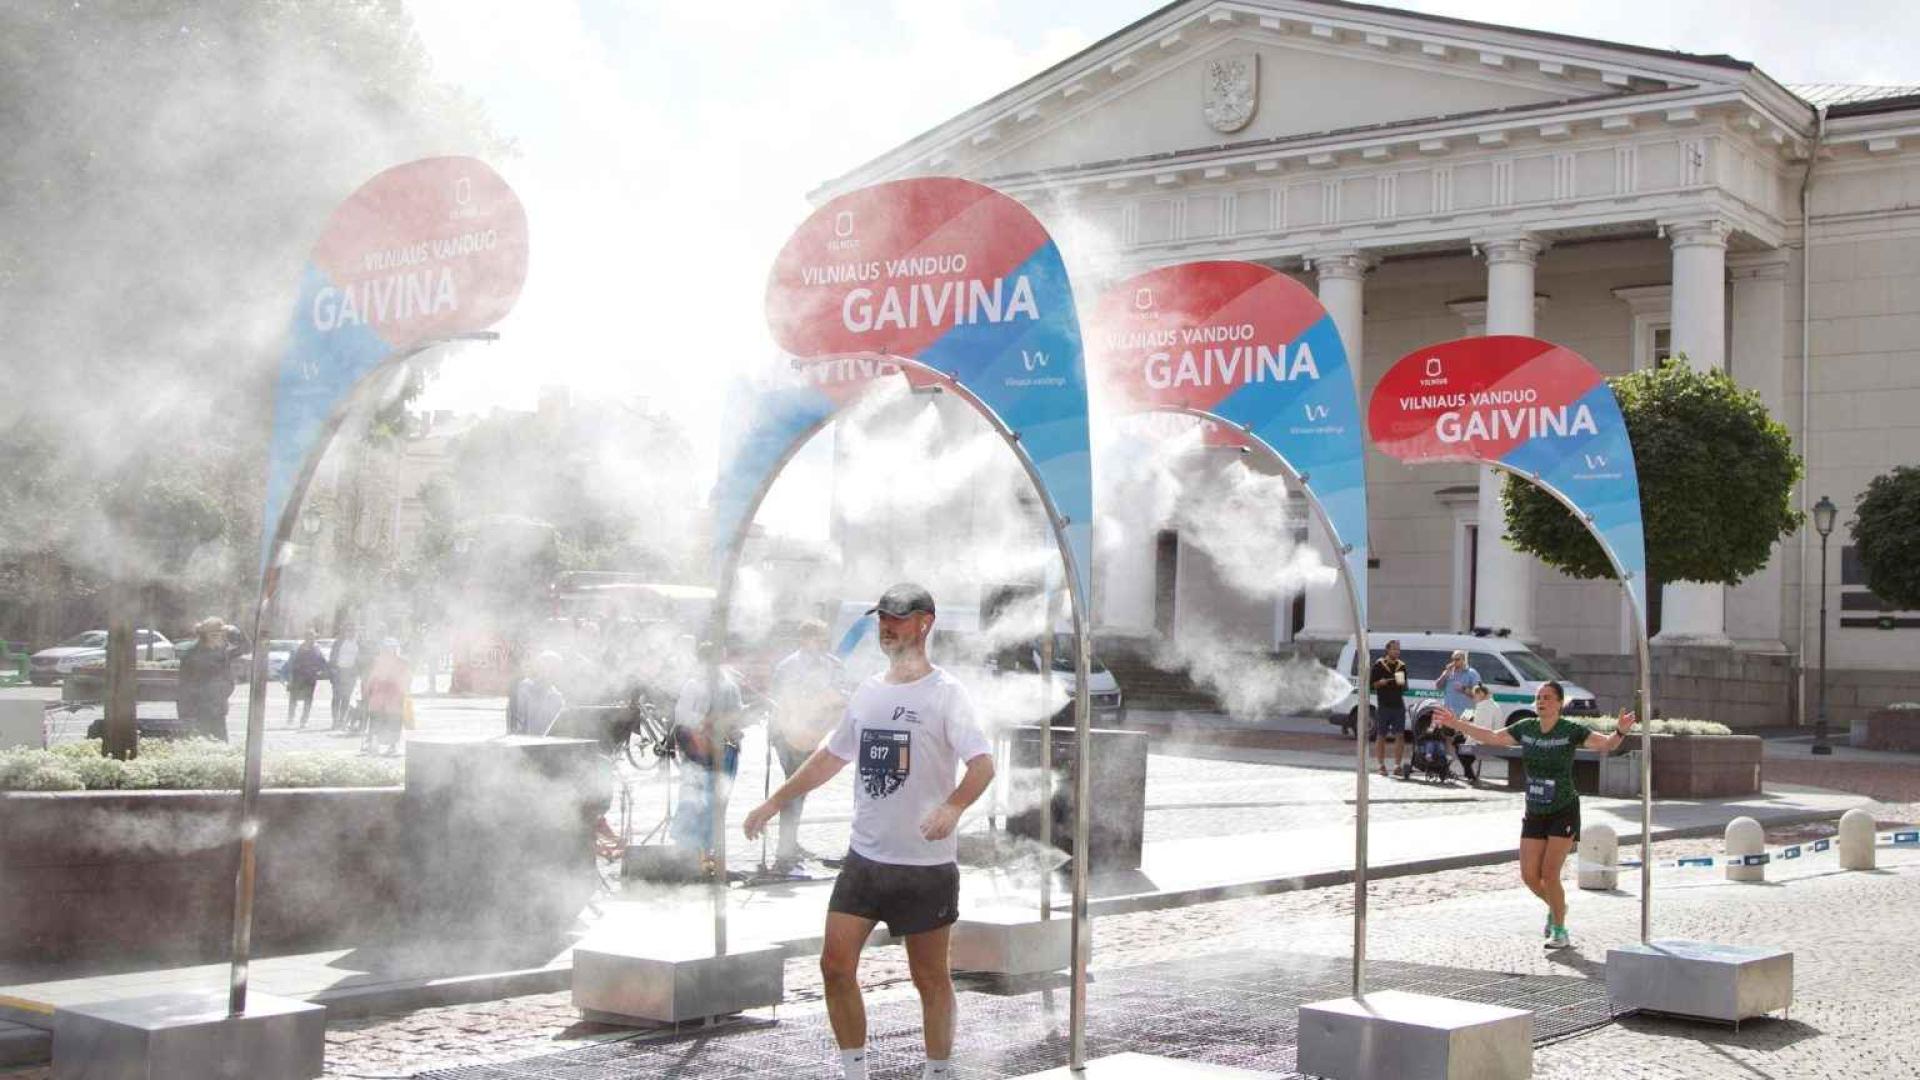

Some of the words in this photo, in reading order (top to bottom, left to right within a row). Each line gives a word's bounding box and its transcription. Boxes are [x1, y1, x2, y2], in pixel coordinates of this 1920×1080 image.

[364, 242, 428, 272] VILNIAUS
[432, 229, 498, 260] VANDUO
[801, 261, 880, 285] VILNIAUS
[885, 254, 967, 279] VANDUO
[313, 267, 458, 332] GAIVINA
[842, 275, 1040, 334] GAIVINA
[1181, 324, 1255, 345] VANDUO
[1144, 342, 1320, 390] GAIVINA
[1399, 393, 1466, 411] VILNIAUS
[1470, 388, 1537, 406] VANDUO
[1435, 404, 1599, 443] GAIVINA
